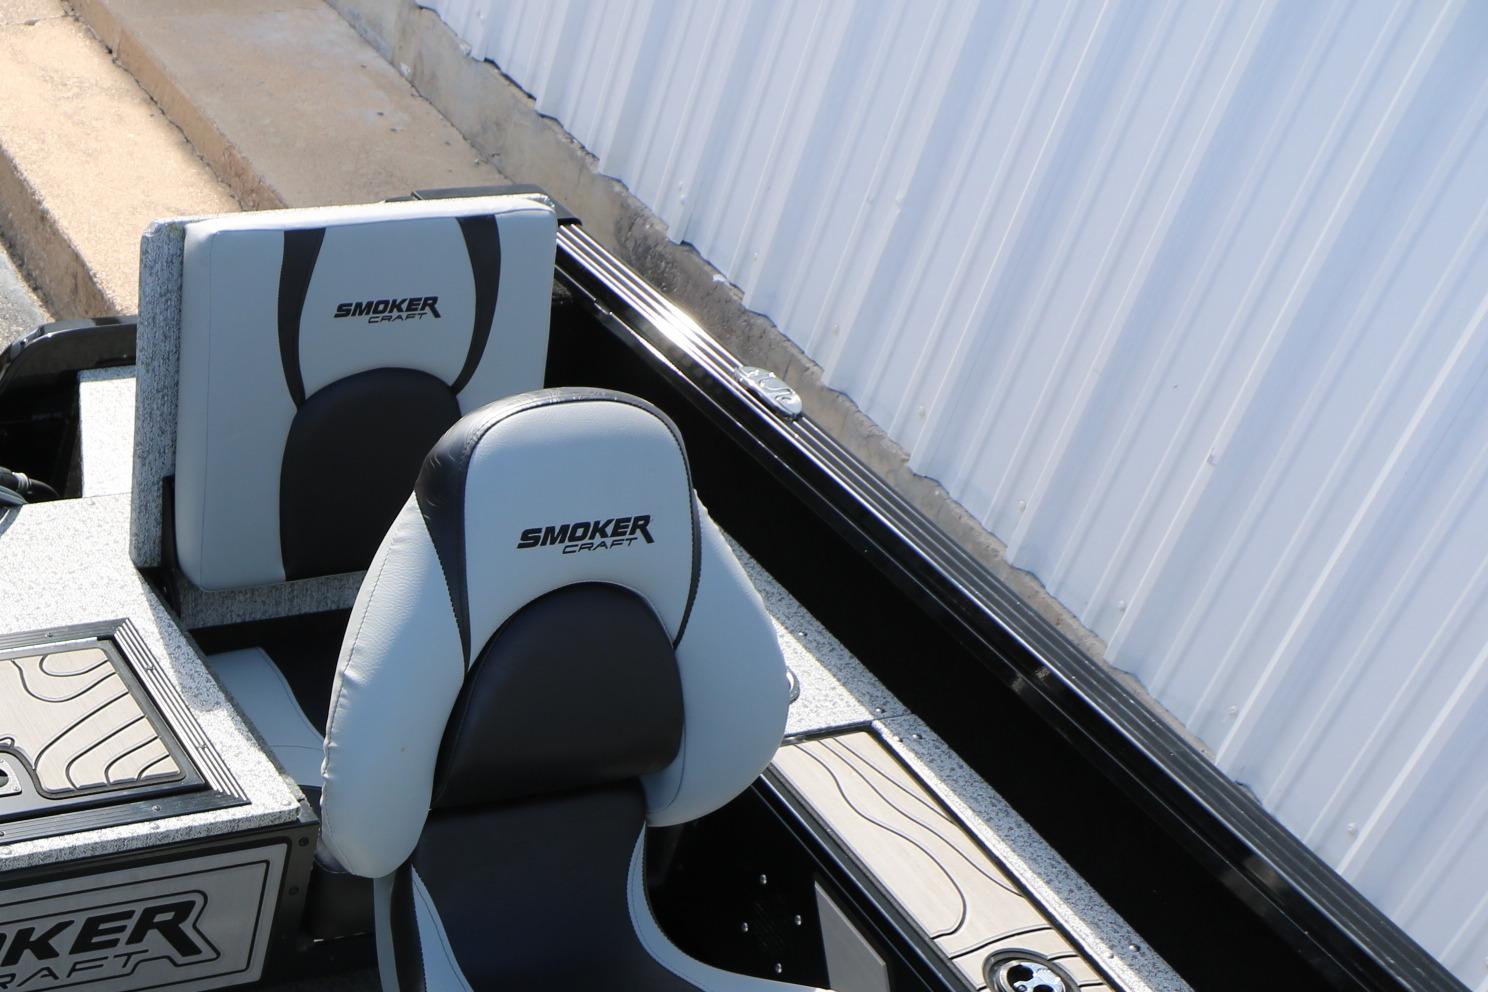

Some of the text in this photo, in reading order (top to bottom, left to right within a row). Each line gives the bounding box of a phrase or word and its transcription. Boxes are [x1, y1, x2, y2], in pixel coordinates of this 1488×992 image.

[334, 296, 441, 318] SMOKER
[368, 312, 427, 324] CRAFT
[517, 514, 654, 549] SMOKER
[562, 537, 638, 554] CRAFT
